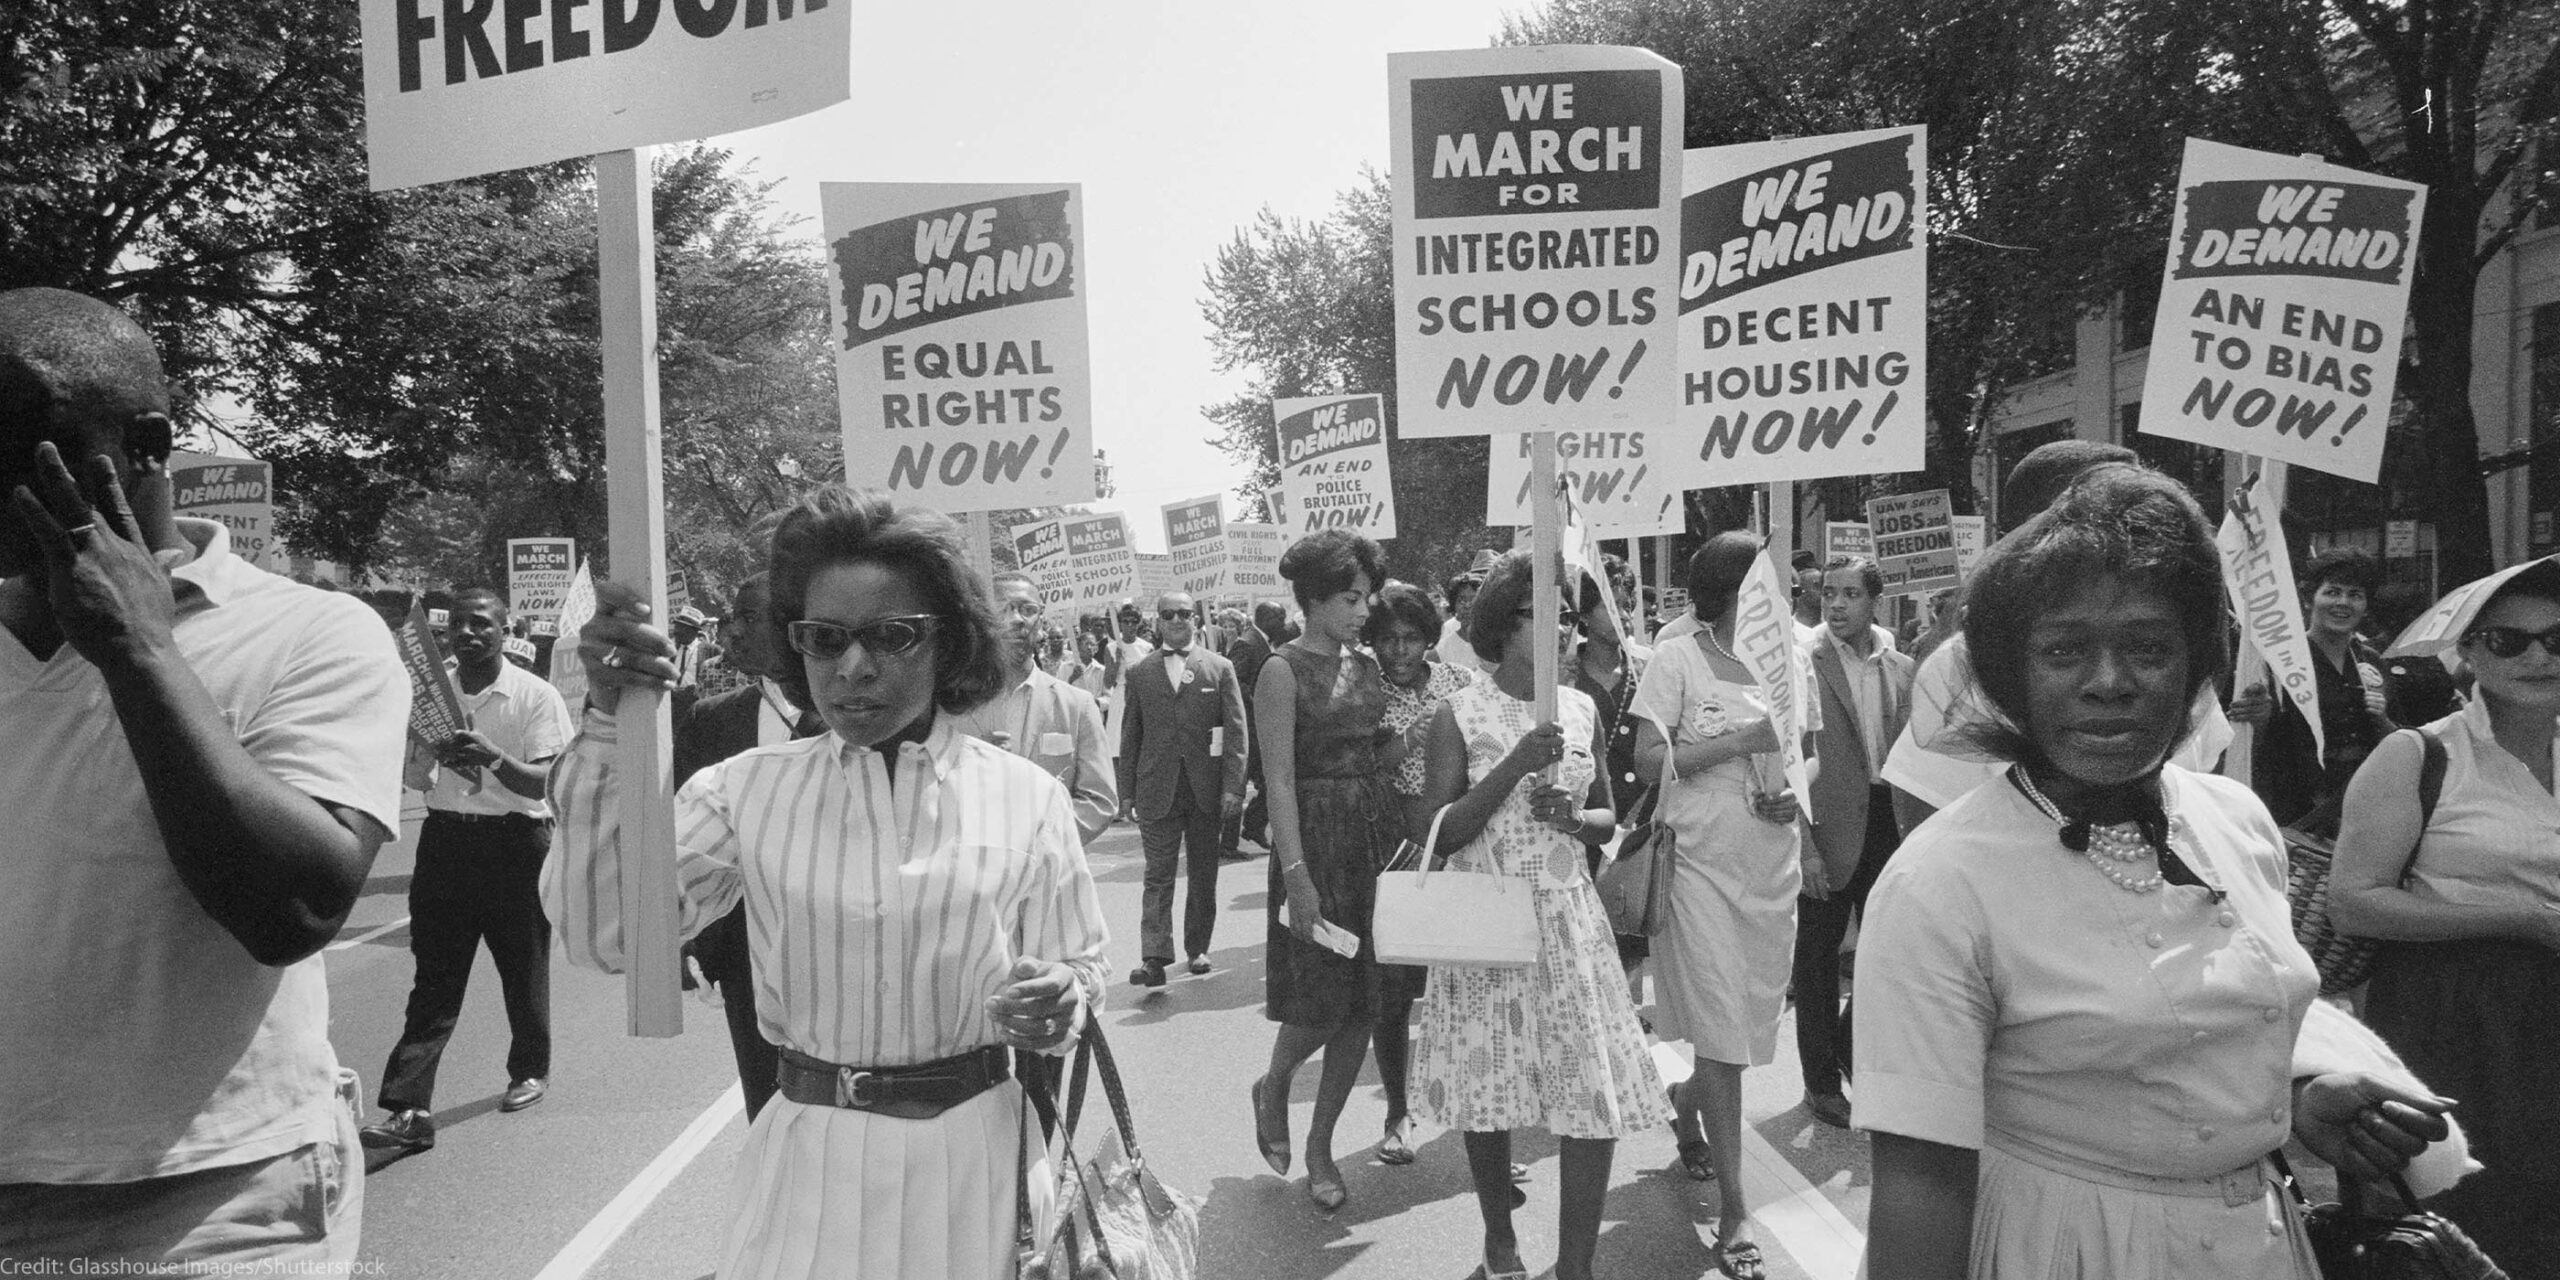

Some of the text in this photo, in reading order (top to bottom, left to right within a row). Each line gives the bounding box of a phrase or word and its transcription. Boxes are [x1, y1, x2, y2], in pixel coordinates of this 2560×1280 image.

[1500, 83, 1574, 121] WE
[1432, 126, 1642, 178] MARCH
[1499, 183, 1580, 206] FOR
[1742, 160, 1833, 228] WE
[2256, 184, 2345, 224] WE
[914, 207, 998, 265] WE
[1680, 191, 1906, 300] DEMAND
[1415, 225, 1660, 275] INTEGRATED
[2190, 226, 2400, 270] DEMAND
[858, 241, 1066, 331] DEMAND
[1417, 286, 1657, 336] SCHOOLS
[2190, 287, 2384, 354] AN END
[1703, 296, 1892, 350] DECENT
[882, 340, 1054, 380] EQUAL
[2190, 330, 2374, 398] TO BIAS
[1435, 338, 1648, 410] NOW!
[1684, 351, 1910, 406] HOUSING
[882, 386, 1063, 429] RIGHTS
[1312, 403, 1349, 431] WE
[2181, 376, 2368, 447] NOW!
[1700, 389, 1899, 462] NOW!
[1289, 417, 1377, 462] DEMAND
[1519, 431, 1646, 459] RGHTS
[887, 426, 1071, 491] NOW!
[1298, 459, 1373, 477] AN END
[201, 466, 238, 485] WE
[1316, 479, 1362, 494] POLICE
[179, 481, 264, 506] DEMAND
[1303, 492, 1372, 509] BRUTALITY
[1876, 496, 1941, 514] UAW SAYS
[187, 511, 259, 530] ENT
[1186, 507, 1201, 518] WE
[1304, 500, 1385, 533] NOW!
[1875, 511, 1948, 536] JOBS and
[1035, 523, 1058, 543] WE
[1072, 528, 1121, 546] MARCH
[1084, 521, 1104, 532] WE
[1173, 515, 1217, 537] MARCH
[1188, 533, 1206, 542] FOR
[1228, 530, 1278, 540] CIVIL RIGHTS
[532, 545, 550, 553] WE
[1023, 537, 1062, 564] DEMA
[1088, 543, 1109, 551] FOR
[1173, 546, 1198, 562] FIRST
[1200, 540, 1225, 556] CLASS
[1242, 546, 1263, 555] FULL
[1833, 536, 1872, 546] MARCH
[1877, 532, 1953, 558] FREEDOM
[516, 554, 566, 565] MARCH
[1030, 559, 1068, 572] AN EN
[1072, 550, 1130, 569] INTEGRATED
[1173, 553, 1228, 576] CITIZENSHIP
[1905, 556, 1929, 566] FOR
[518, 573, 568, 581] EFFECTIVE
[1075, 564, 1133, 582] SCHOOLS
[1183, 568, 1226, 593] NOW!
[1232, 573, 1277, 586] REEDOM
[1910, 564, 1956, 580] American
[511, 581, 571, 590] CIVIL RIGHTS
[1039, 587, 1074, 605] NOW
[1083, 576, 1132, 599] NOW!
[539, 623, 559, 634] UA
[1737, 580, 1792, 719] FREEDOM
[2278, 650, 2294, 668] IN
[402, 620, 431, 675] MARCH
[428, 681, 457, 734] WASHINGT
[423, 701, 455, 743] FREEDO
